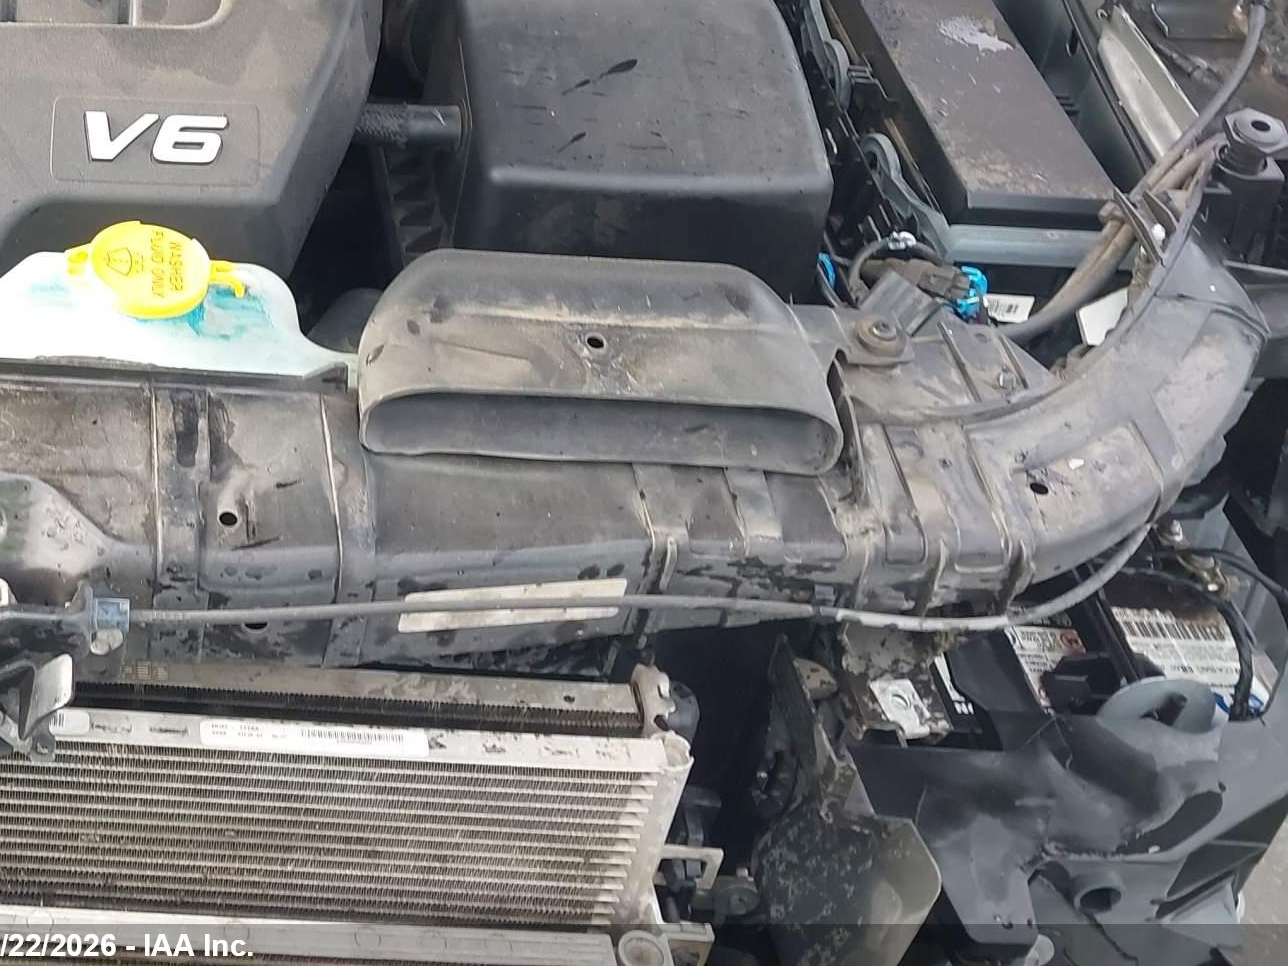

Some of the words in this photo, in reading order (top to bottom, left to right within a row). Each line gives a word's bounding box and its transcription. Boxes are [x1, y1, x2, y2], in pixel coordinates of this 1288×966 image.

[84, 110, 230, 165] V6
[150, 229, 164, 264] FLUID
[168, 241, 183, 291] WASHER
[150, 268, 165, 299] ONLY
